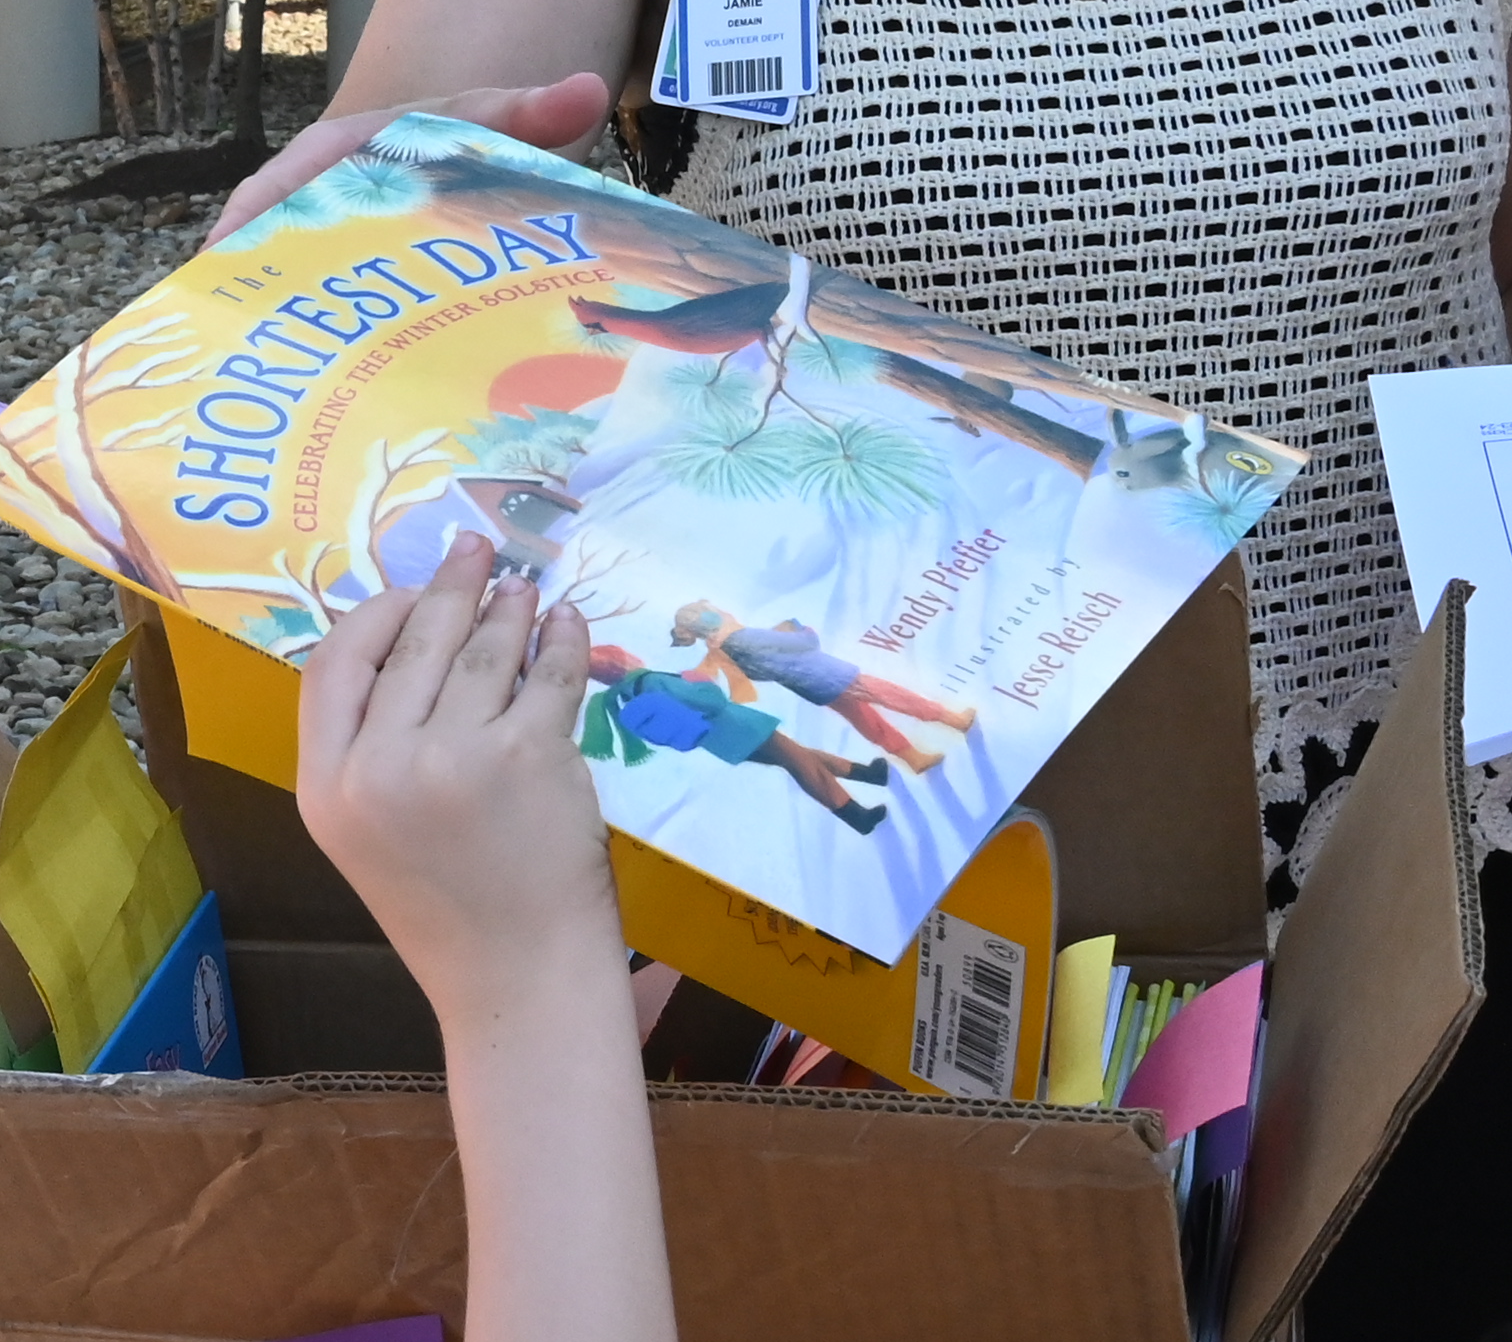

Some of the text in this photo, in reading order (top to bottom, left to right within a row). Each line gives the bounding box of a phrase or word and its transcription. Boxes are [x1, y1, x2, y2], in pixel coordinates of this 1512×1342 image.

[704, 32, 785, 48] VOLUNTEER DEPT
[727, 17, 763, 28] DEMAIN
[210, 264, 283, 304] The
[174, 213, 598, 529] SHORTEST DAY
[294, 267, 616, 534] CELEBRATING THE WINTER SOLSTICE
[858, 528, 1008, 654] Wendy Pfeffer
[940, 556, 1081, 694] illustrated by
[992, 589, 1123, 711] Jesse Reisch
